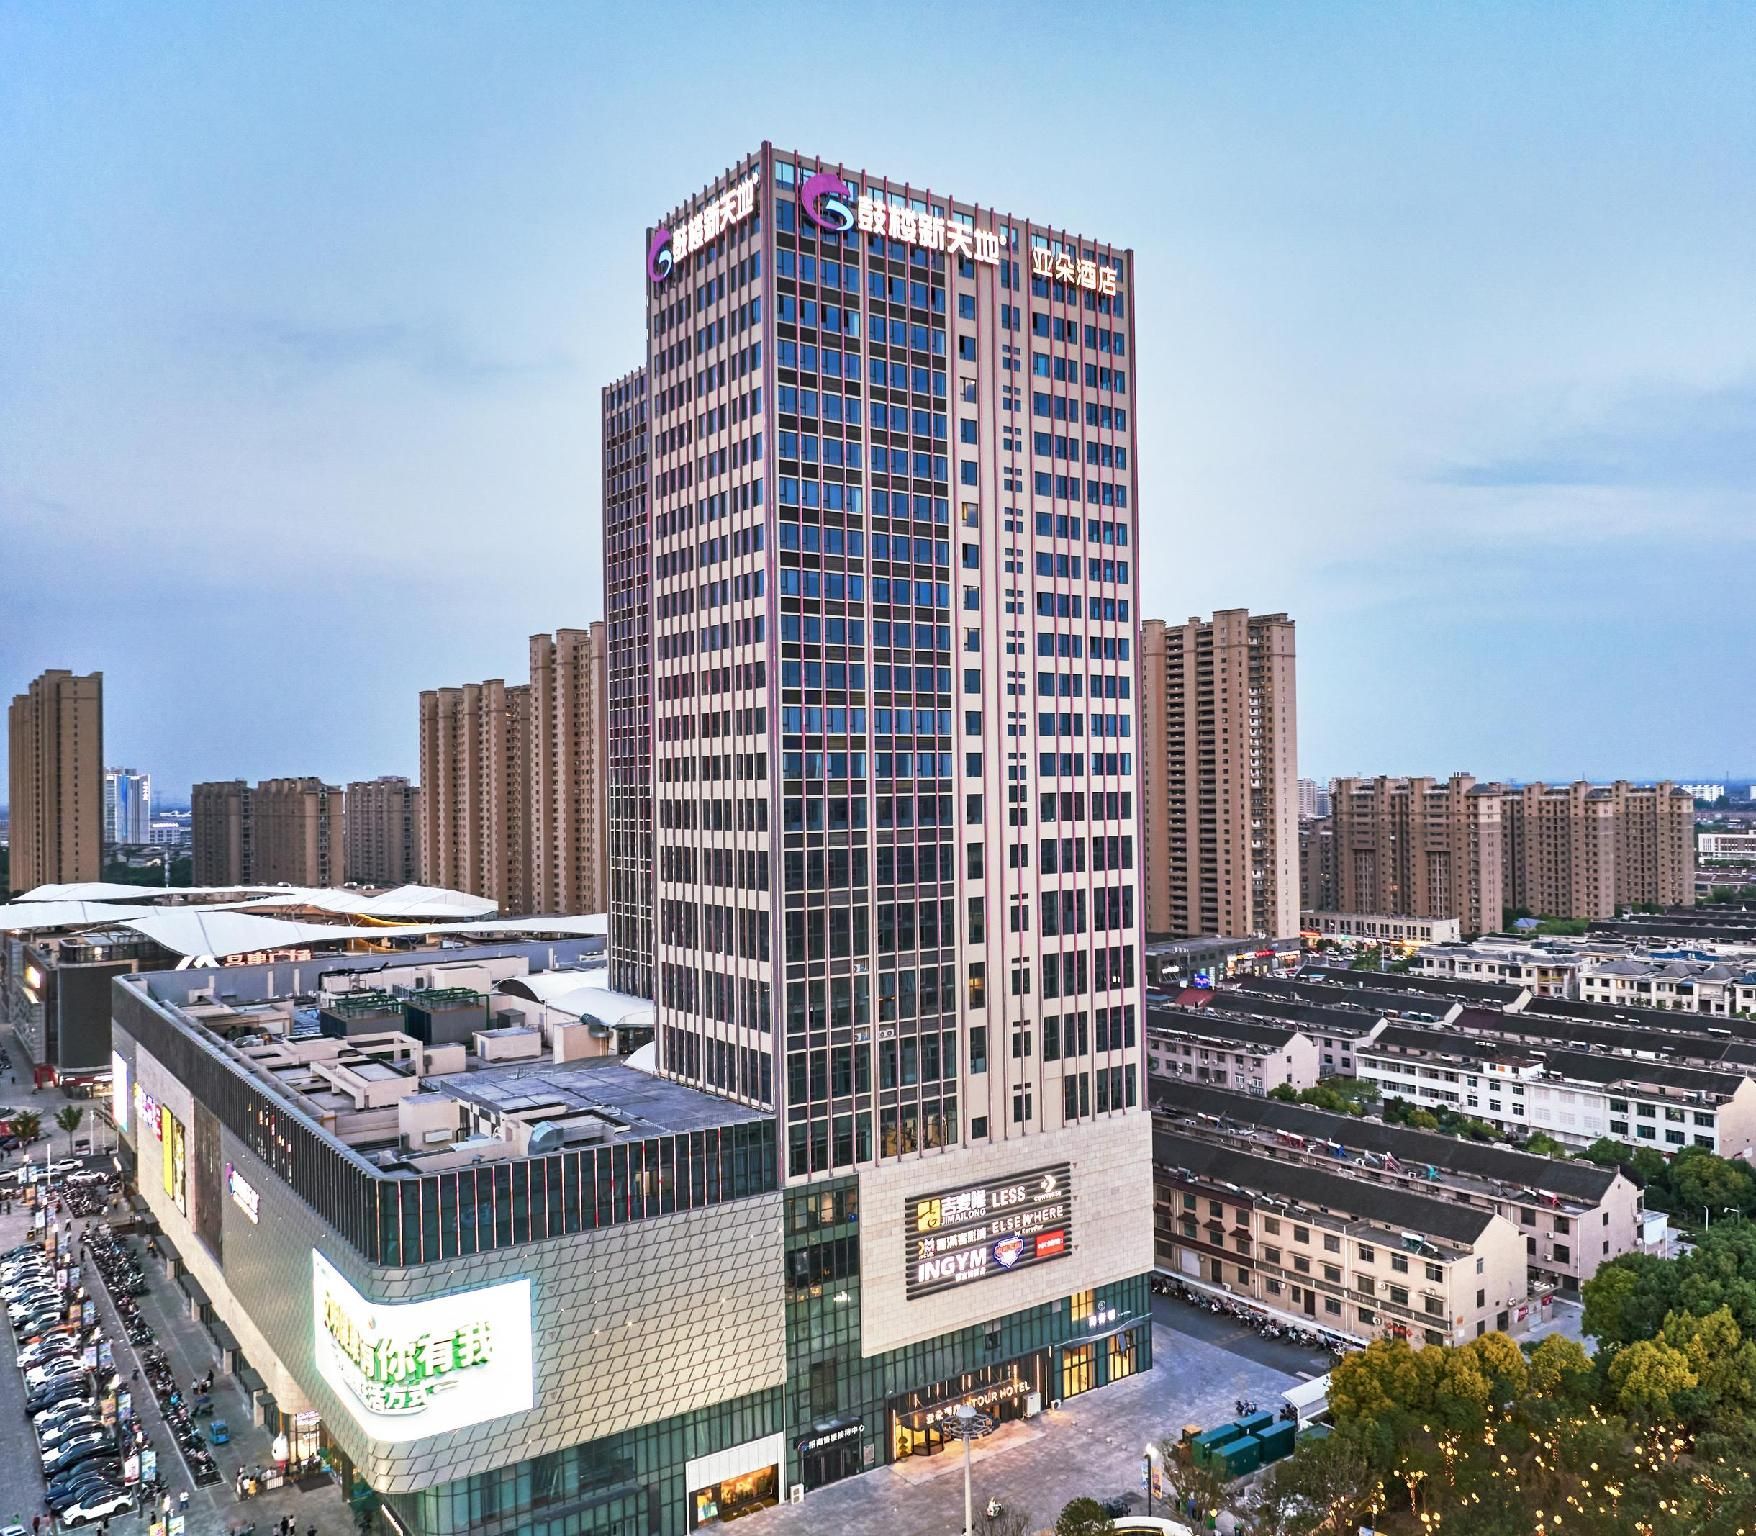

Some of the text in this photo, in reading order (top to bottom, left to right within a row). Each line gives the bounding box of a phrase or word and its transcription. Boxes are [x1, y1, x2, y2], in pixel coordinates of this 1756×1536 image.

[858, 196, 1000, 265] 鼓楼新天地
[1033, 246, 1117, 296] 亚朵酒店
[992, 1186, 1026, 1208] LESS
[941, 1208, 986, 1226] JIMAILONG
[992, 1206, 1063, 1234] ELSEWHERE
[919, 1248, 987, 1283] INGYM
[1000, 1380, 1031, 1400] HOTEL
